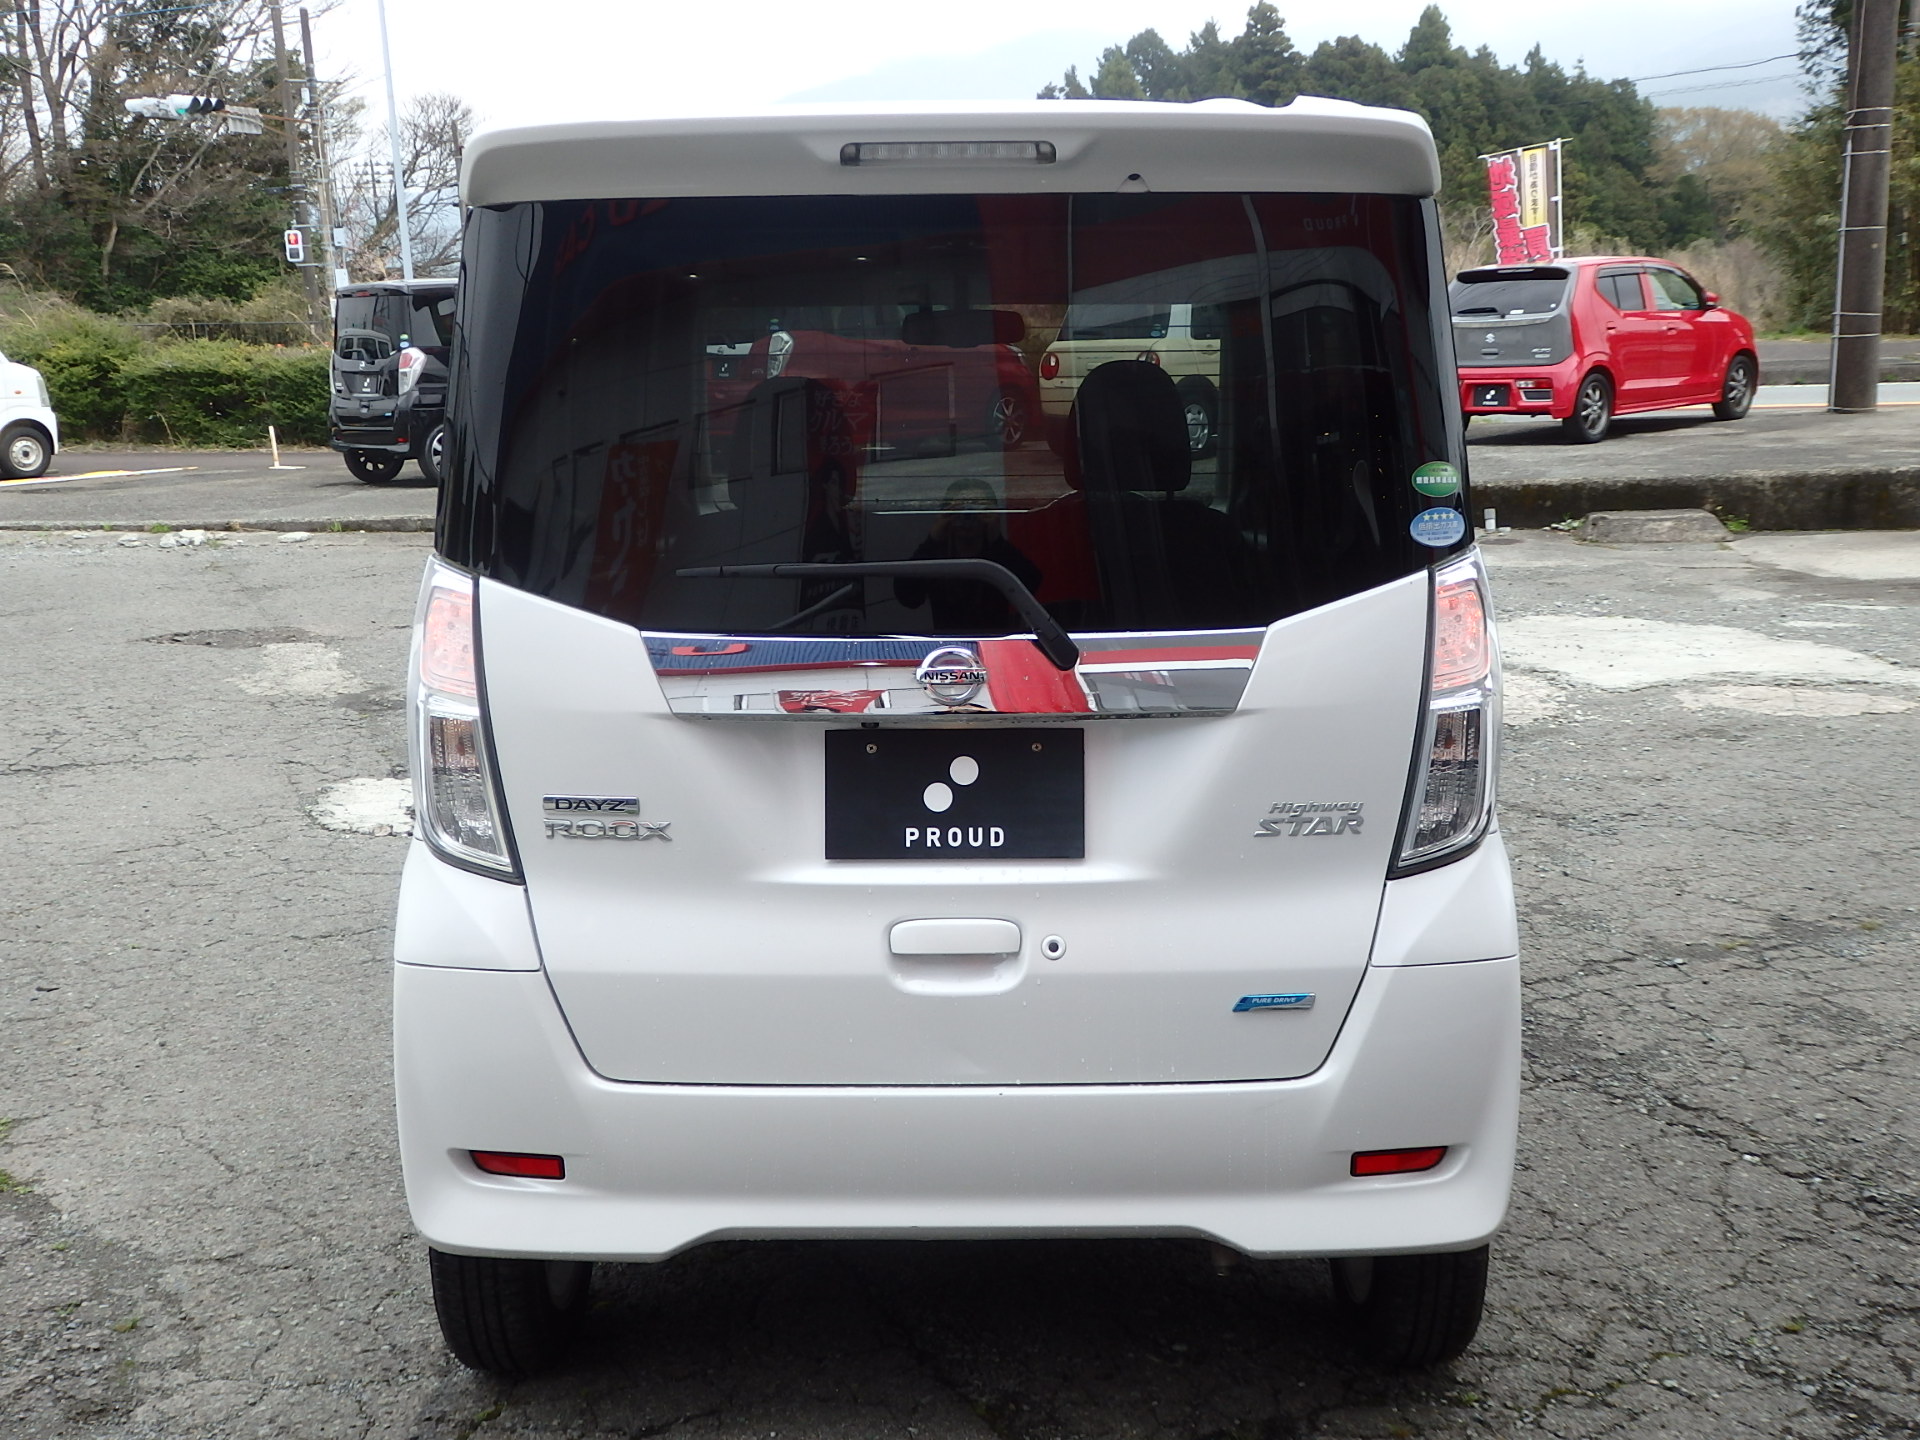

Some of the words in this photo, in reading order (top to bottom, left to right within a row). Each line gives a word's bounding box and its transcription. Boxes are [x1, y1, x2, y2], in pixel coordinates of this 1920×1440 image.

[924, 671, 981, 681] NISSAN
[554, 798, 627, 812] DAYZ
[1269, 801, 1364, 817] Highway
[543, 818, 673, 841] ROOX
[1254, 816, 1364, 837] STAR
[905, 826, 1005, 848] PROUD
